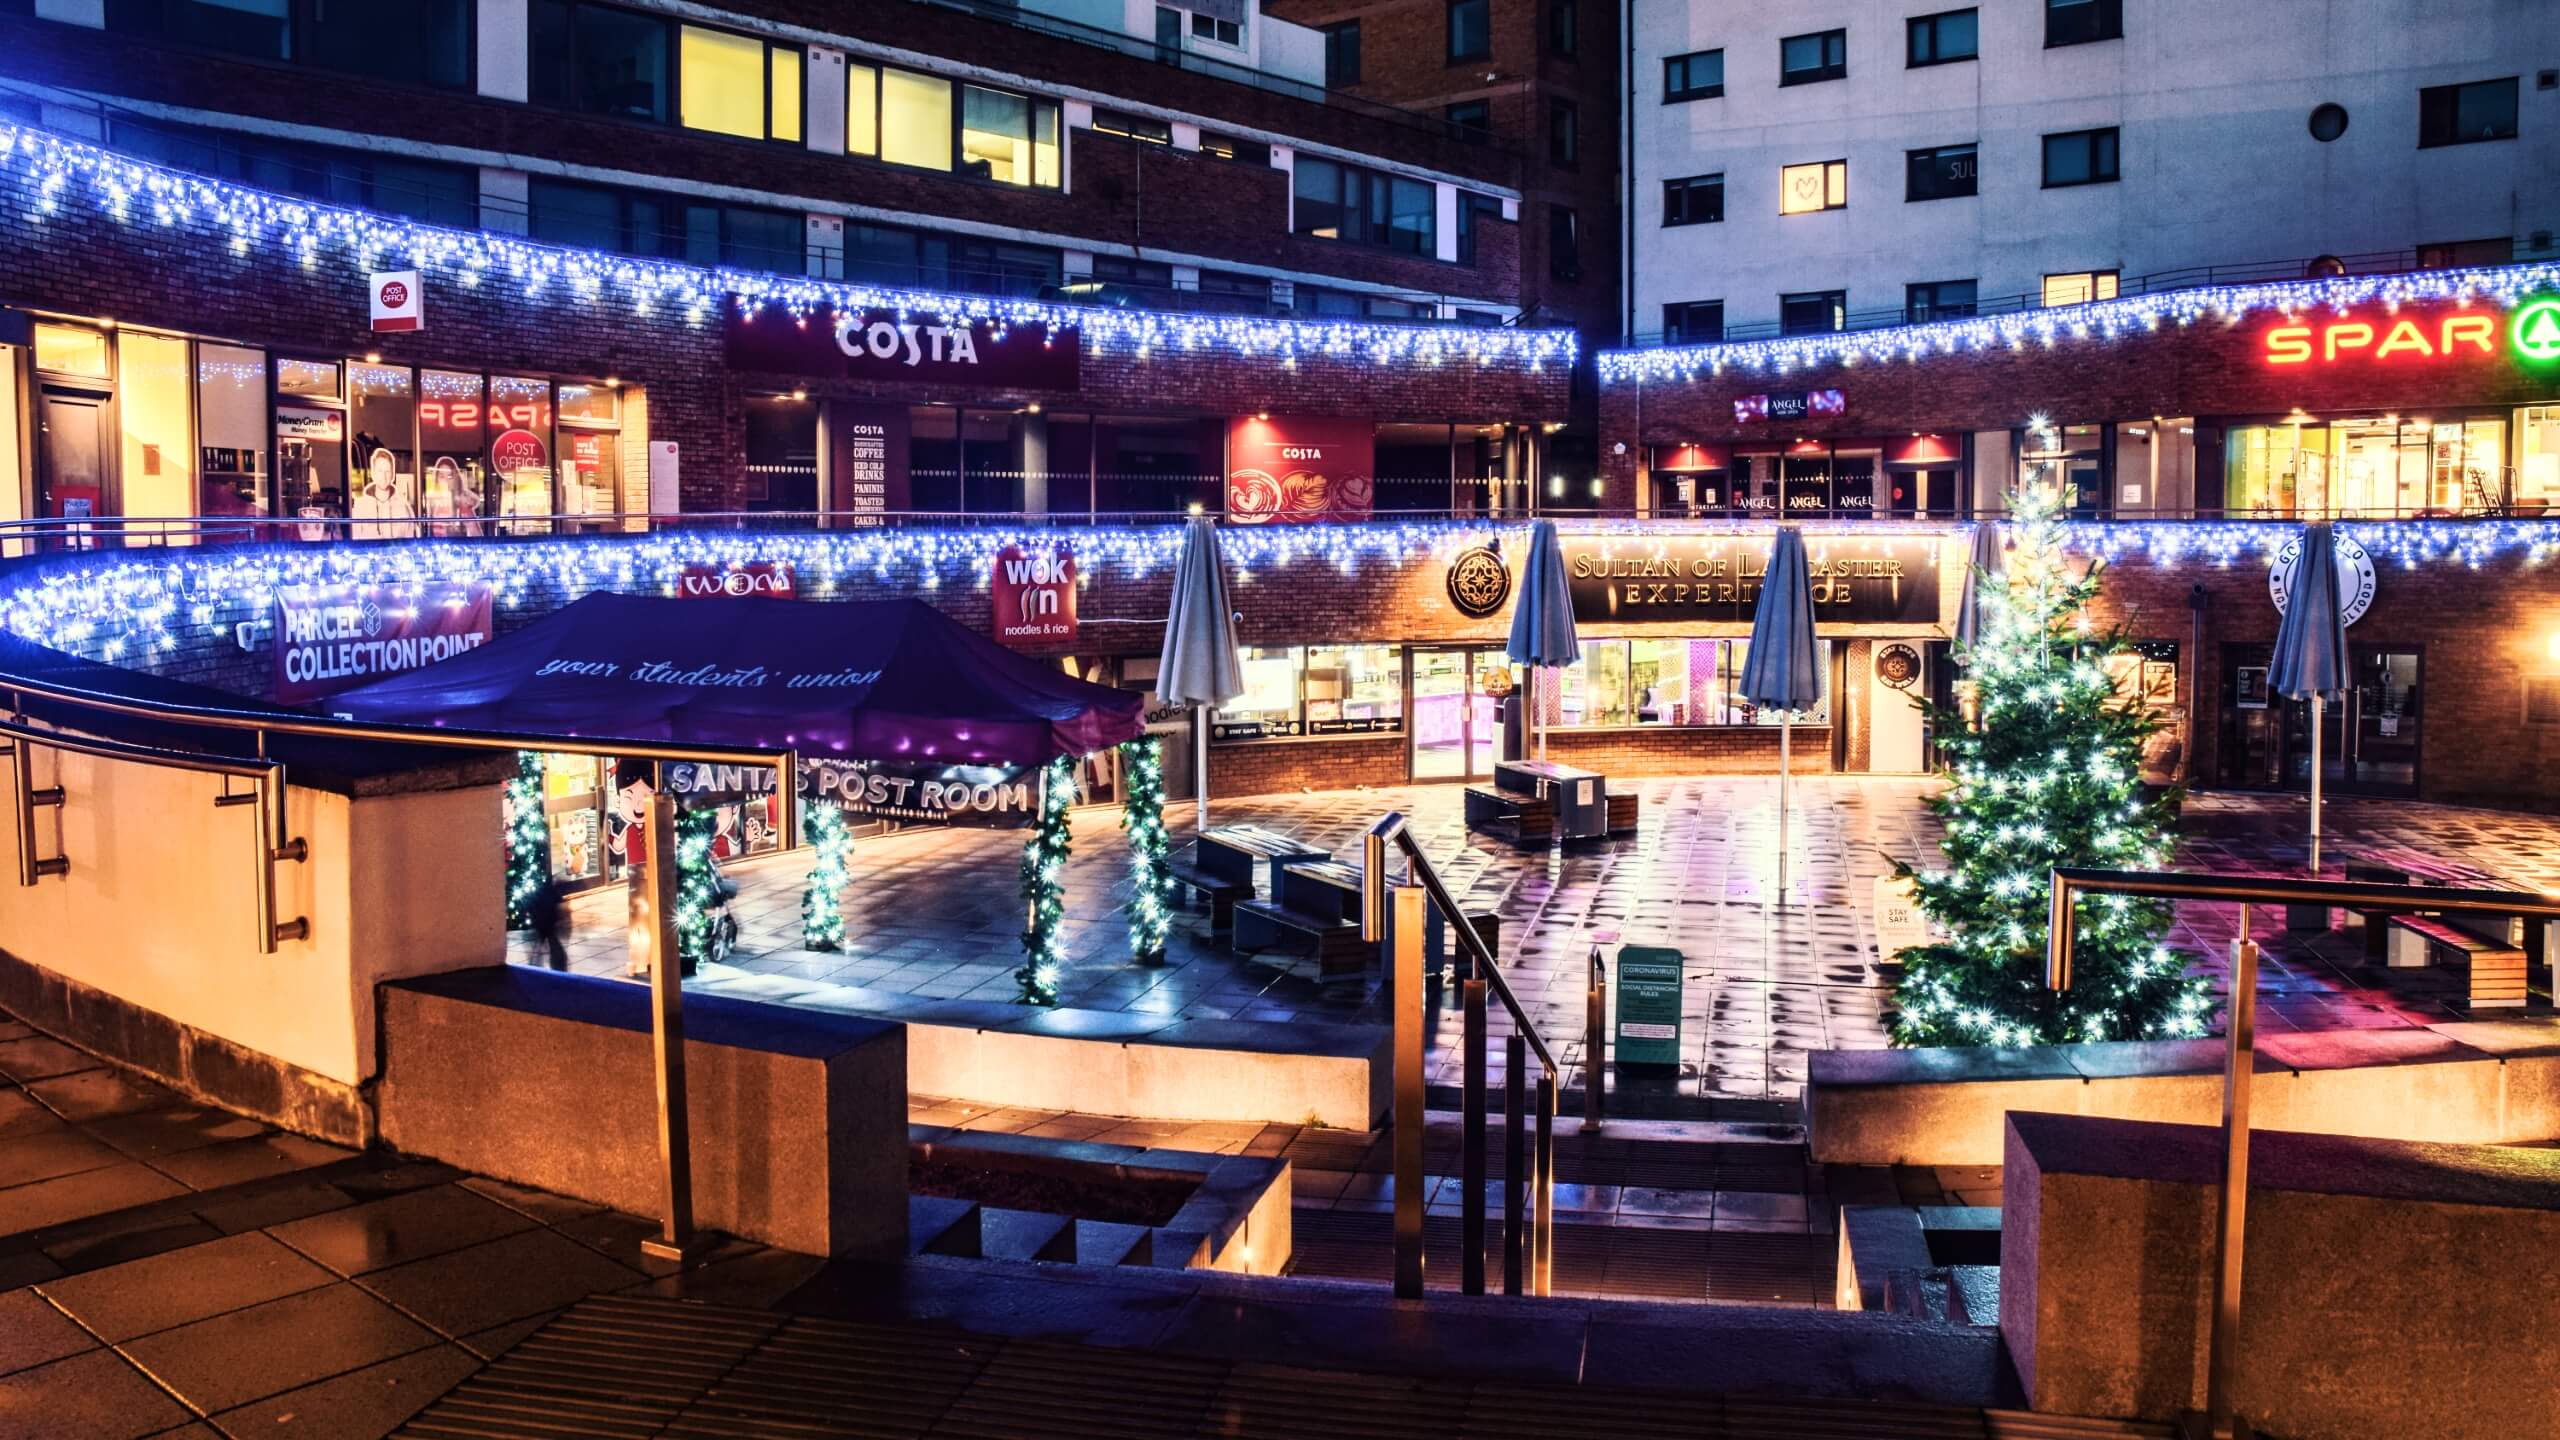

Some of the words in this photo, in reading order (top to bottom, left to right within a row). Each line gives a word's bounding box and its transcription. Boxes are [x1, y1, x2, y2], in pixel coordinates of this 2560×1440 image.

[385, 286, 402, 294] POST
[382, 294, 405, 303] OFFICE
[835, 319, 979, 367] COSTA
[2265, 315, 2495, 364] SPAR
[1771, 399, 1806, 411] ANGEL
[853, 425, 885, 435] COSTA
[506, 441, 536, 456] POST
[854, 447, 885, 459] COFFEE
[1282, 447, 1322, 460] COSTA
[499, 455, 540, 469] OFFICE
[854, 469, 885, 481] DRINKS
[854, 483, 885, 494] PANINIS
[854, 496, 885, 506] TOASTED
[1739, 497, 1776, 509] ANGEL
[1788, 495, 1826, 509] ANGEL
[1839, 495, 1875, 507] ANGEL
[854, 515, 877, 526] CAKES
[1005, 547, 1069, 585] wok
[1573, 552, 1681, 579] SULTAN
[1691, 558, 1728, 578] OF
[1738, 551, 1905, 579] LCASTER
[1625, 583, 1853, 603] EXPERICE
[2353, 583, 2373, 613] FOOD
[285, 606, 363, 643] PARCEL
[1005, 624, 1042, 636] noodles
[1043, 623, 1051, 634] &
[1052, 623, 1069, 634] rice
[285, 637, 417, 683] COLLECTION
[420, 632, 484, 667] POINT
[536, 656, 620, 678] your
[786, 666, 882, 688] union
[818, 766, 914, 806] POST
[920, 780, 1028, 813] ROOM
[1889, 908, 1908, 916] STAY
[1623, 966, 1677, 976] CORONAVIRUS
